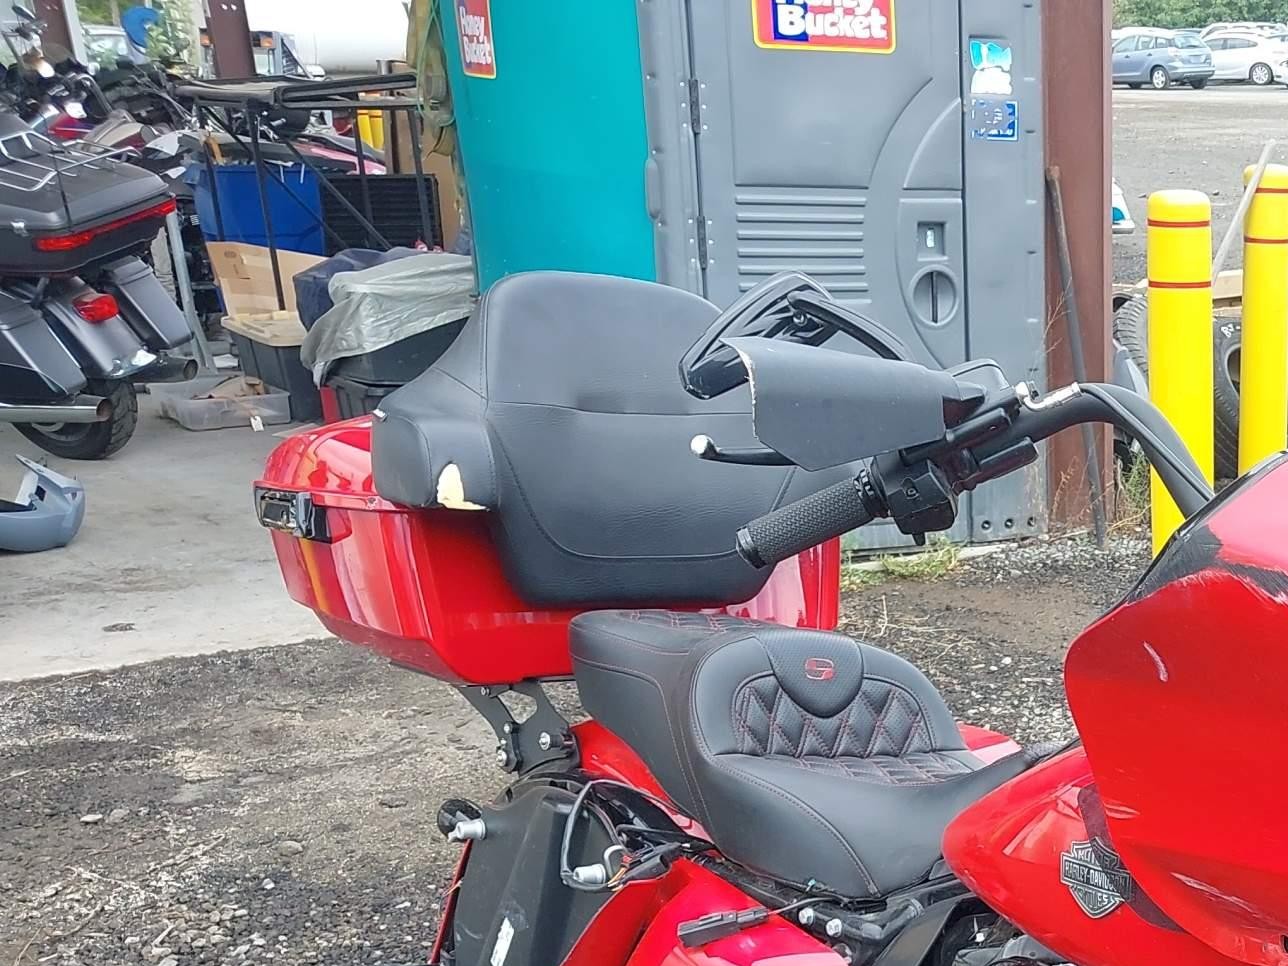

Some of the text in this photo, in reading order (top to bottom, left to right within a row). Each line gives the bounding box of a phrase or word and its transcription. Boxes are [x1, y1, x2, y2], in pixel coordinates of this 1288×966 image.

[459, 6, 486, 43] Honey
[777, 4, 887, 40] Bucket
[463, 36, 492, 65] Bucket
